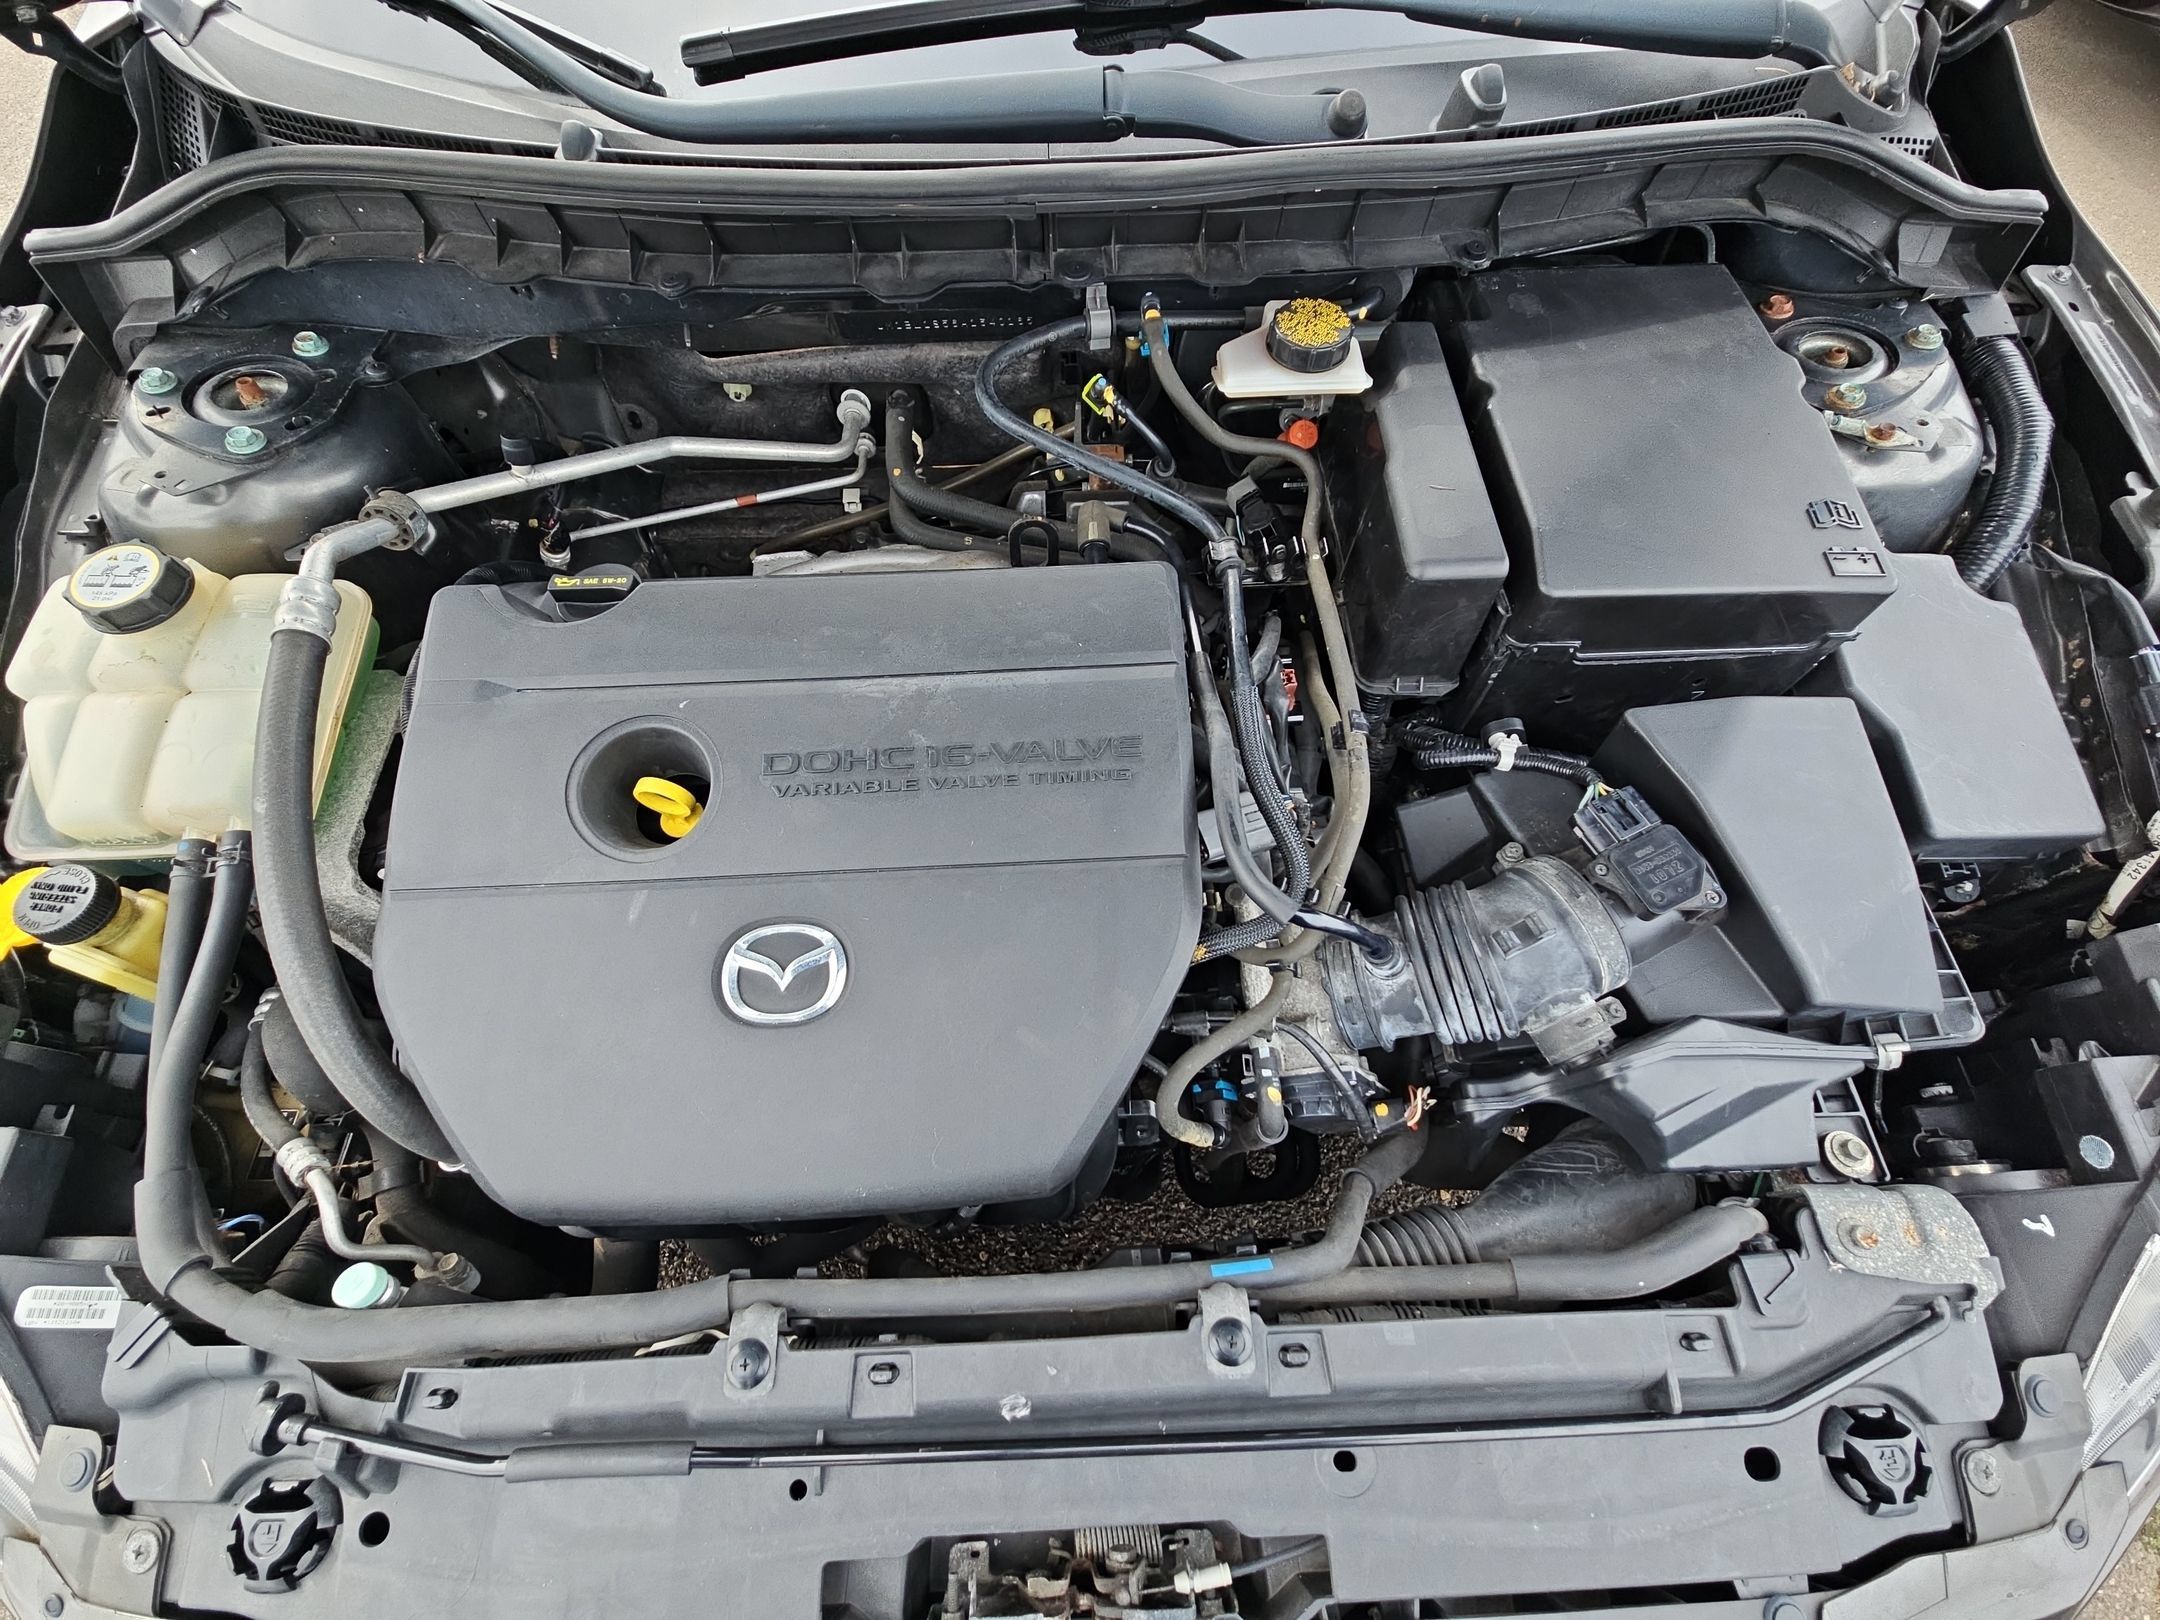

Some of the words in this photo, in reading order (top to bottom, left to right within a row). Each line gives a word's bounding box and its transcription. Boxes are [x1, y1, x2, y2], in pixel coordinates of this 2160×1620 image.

[583, 577, 598, 585] SAE
[762, 746, 915, 776] DOHC
[925, 735, 1144, 768] 16-VALVE
[771, 778, 920, 798] VARIABLE
[928, 773, 1021, 790] VALVE
[1028, 768, 1133, 785] TIMING
[62, 867, 91, 885] CLOSE
[30, 881, 55, 891] ONLY
[57, 883, 90, 894] FLUID
[28, 892, 79, 904] STEERING
[29, 902, 64, 913] POWER
